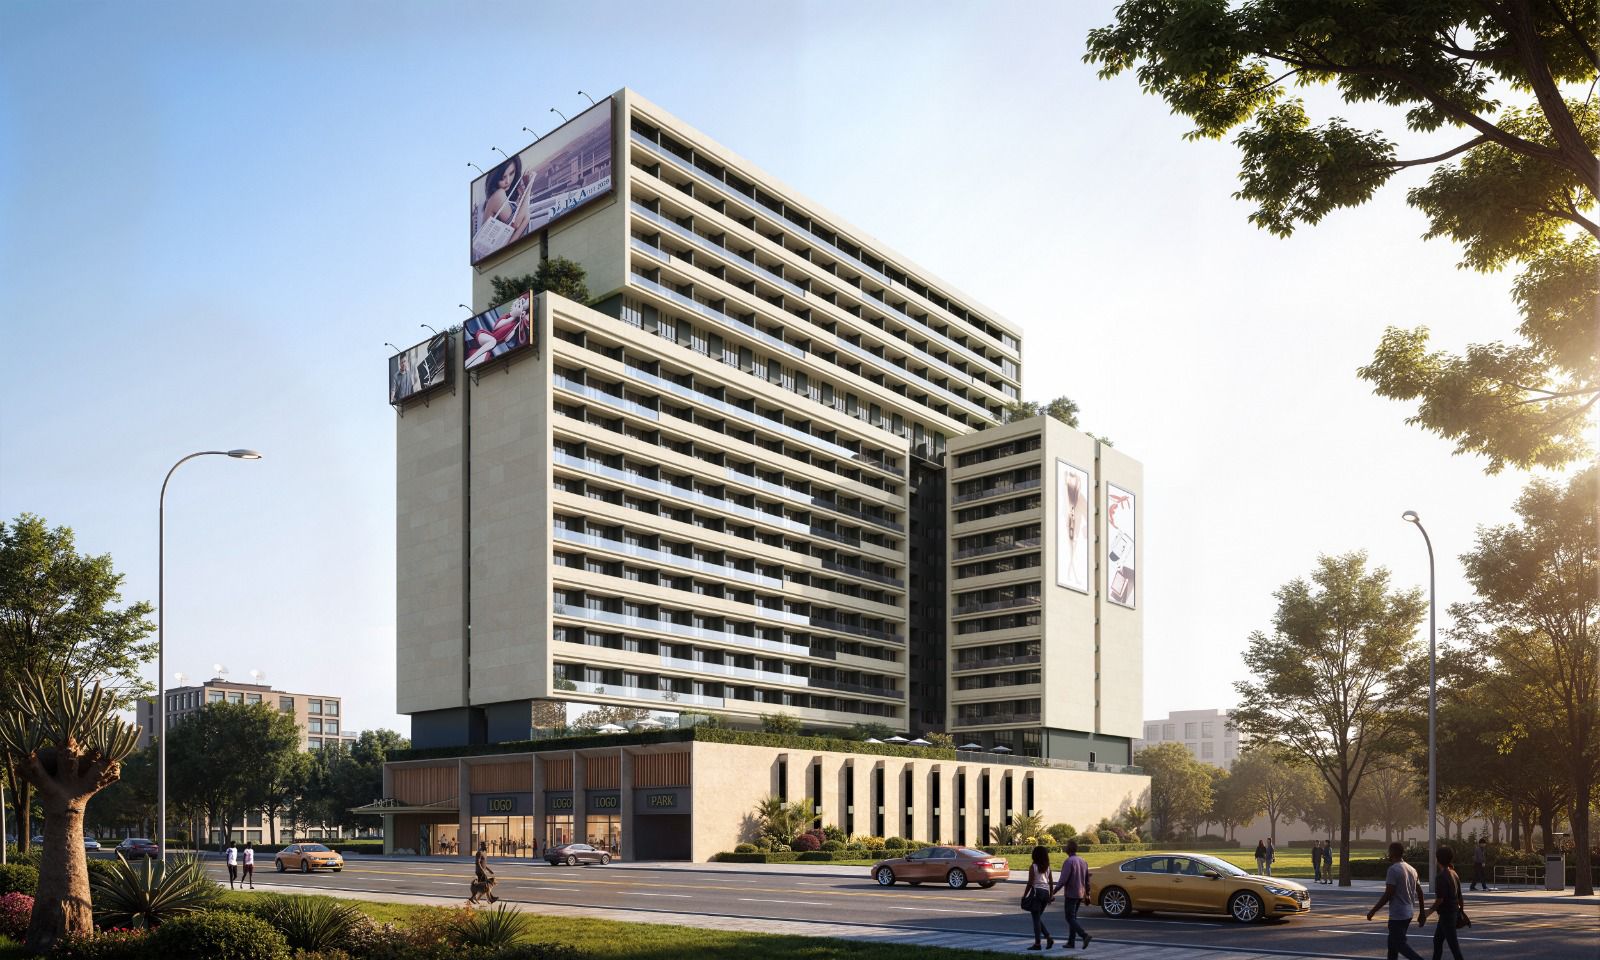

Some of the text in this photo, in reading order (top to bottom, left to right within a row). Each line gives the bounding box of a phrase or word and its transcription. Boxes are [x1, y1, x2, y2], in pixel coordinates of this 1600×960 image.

[489, 799, 512, 811] LOGO
[553, 798, 572, 809] LOGO
[595, 797, 617, 808] LOGO
[651, 795, 673, 806] PARK
